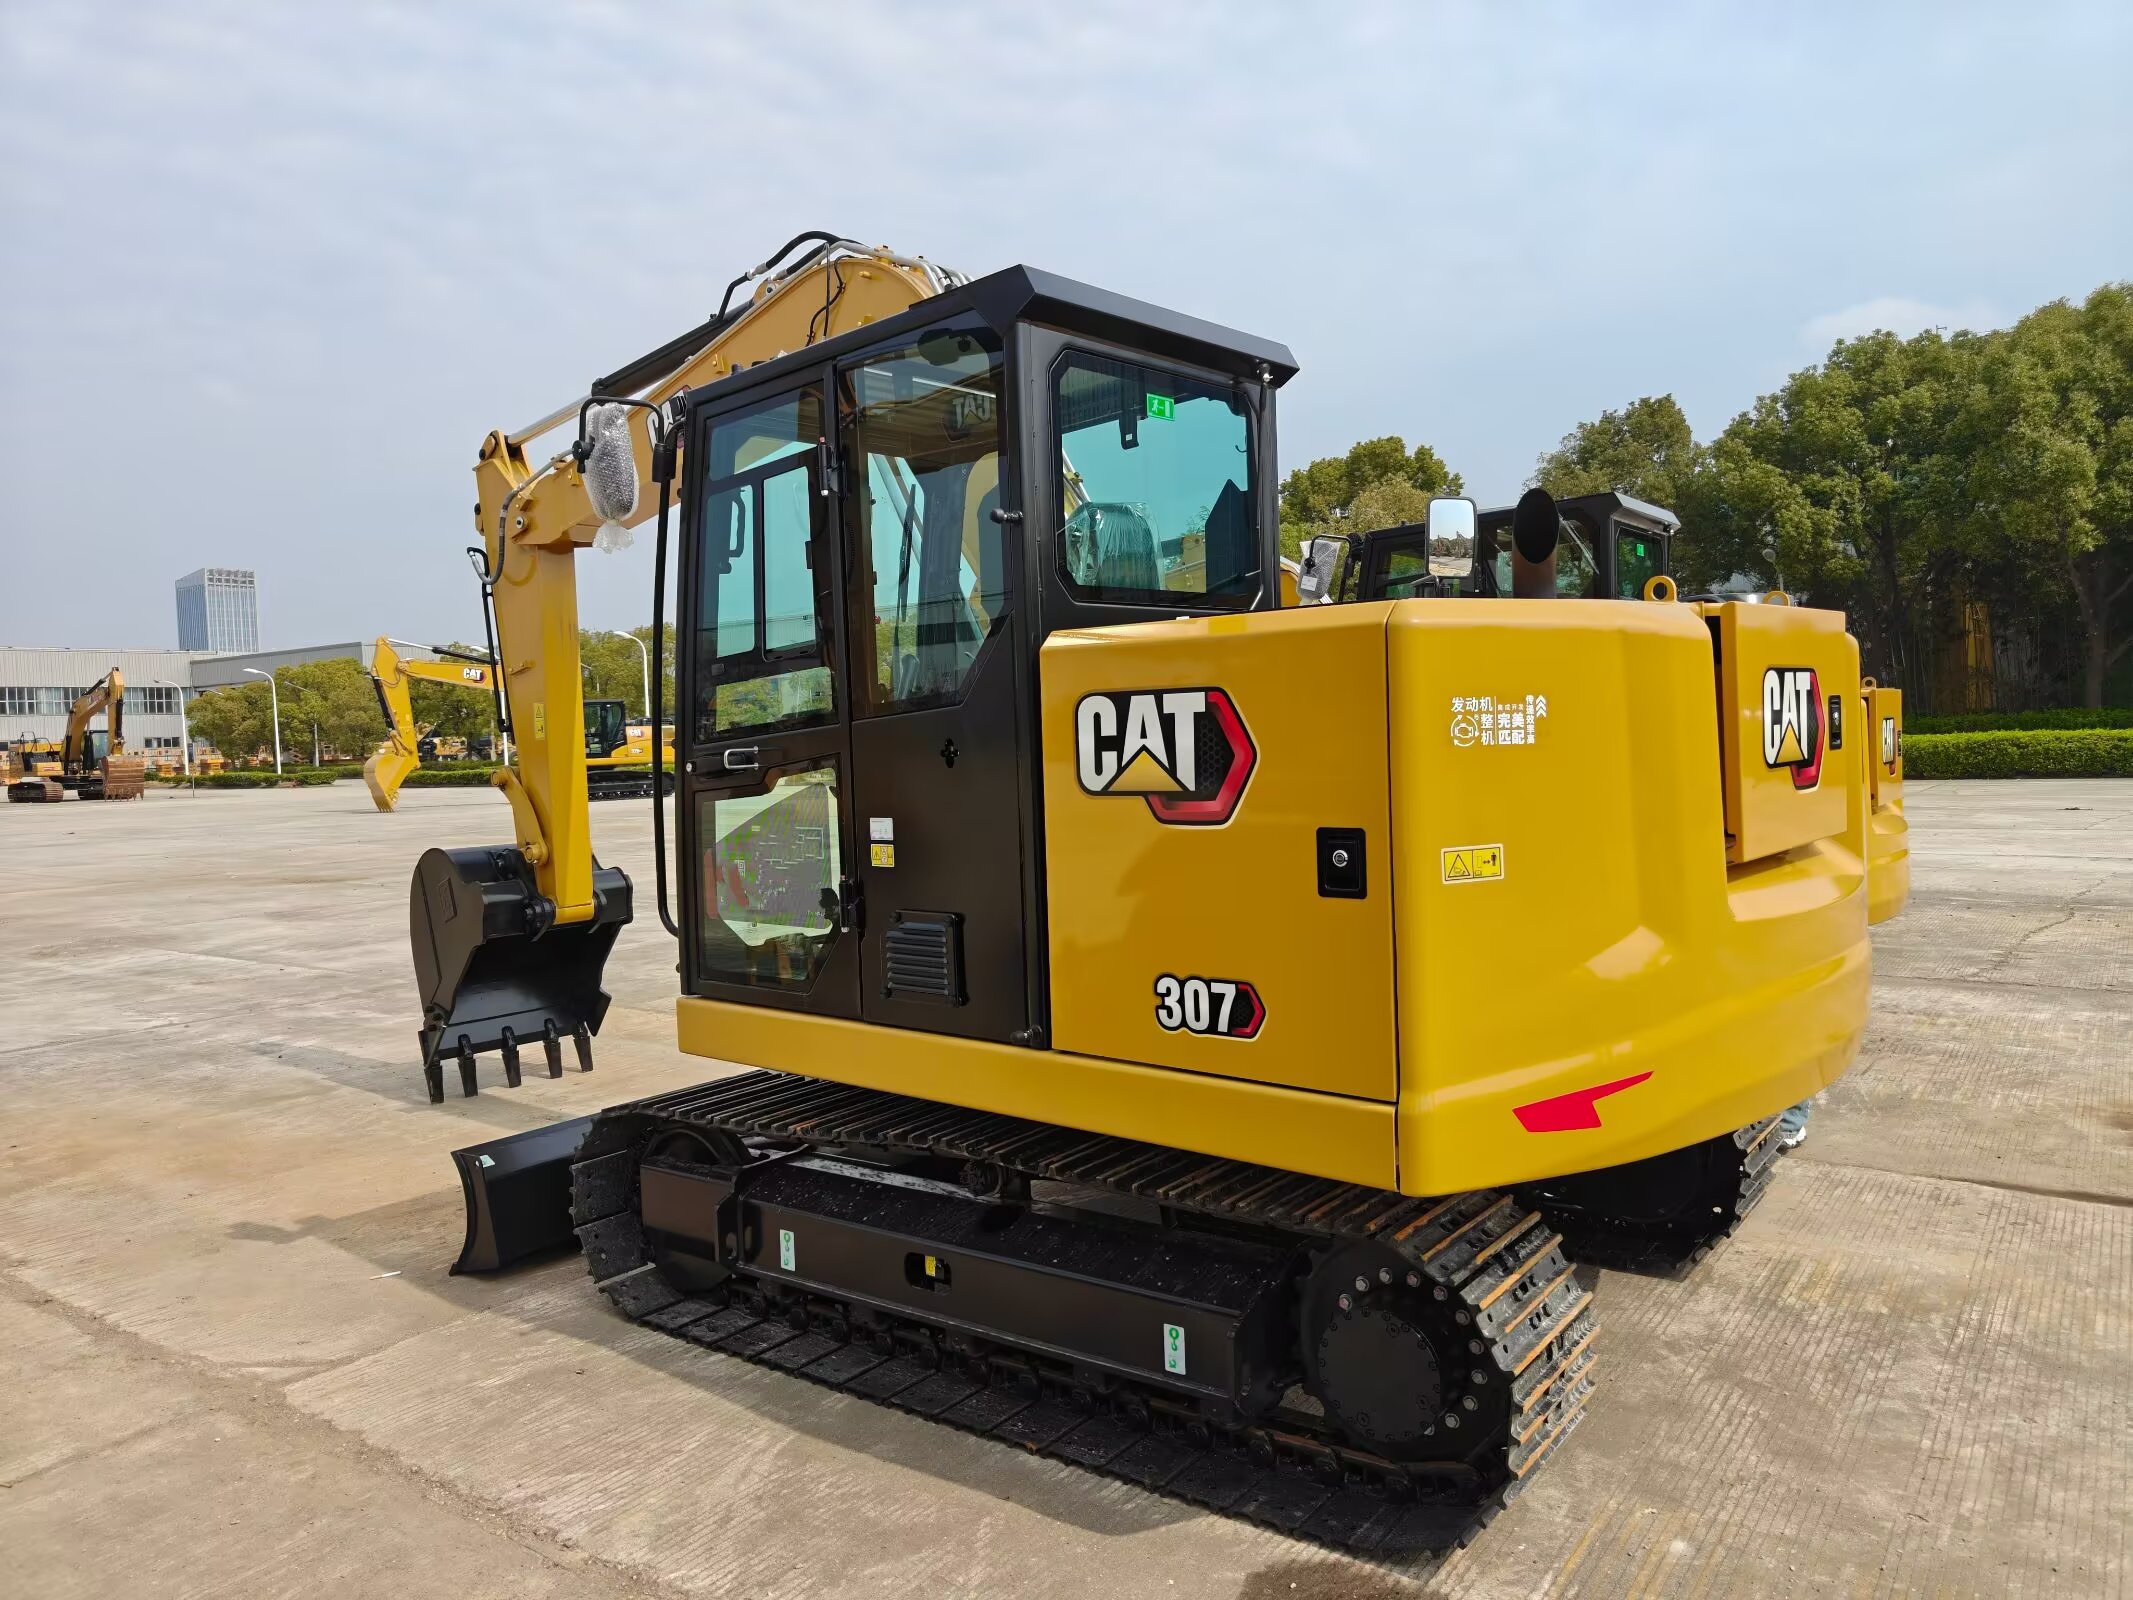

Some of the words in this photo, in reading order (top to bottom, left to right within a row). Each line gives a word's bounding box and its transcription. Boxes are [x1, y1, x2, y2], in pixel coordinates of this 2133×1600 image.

[463, 667, 482, 681] CAT
[1451, 696, 1494, 713] 发动机
[1763, 669, 1811, 765] CAT
[1077, 691, 1206, 792] CAT
[1882, 719, 1894, 763] CAT
[1156, 976, 1237, 1033] 307
